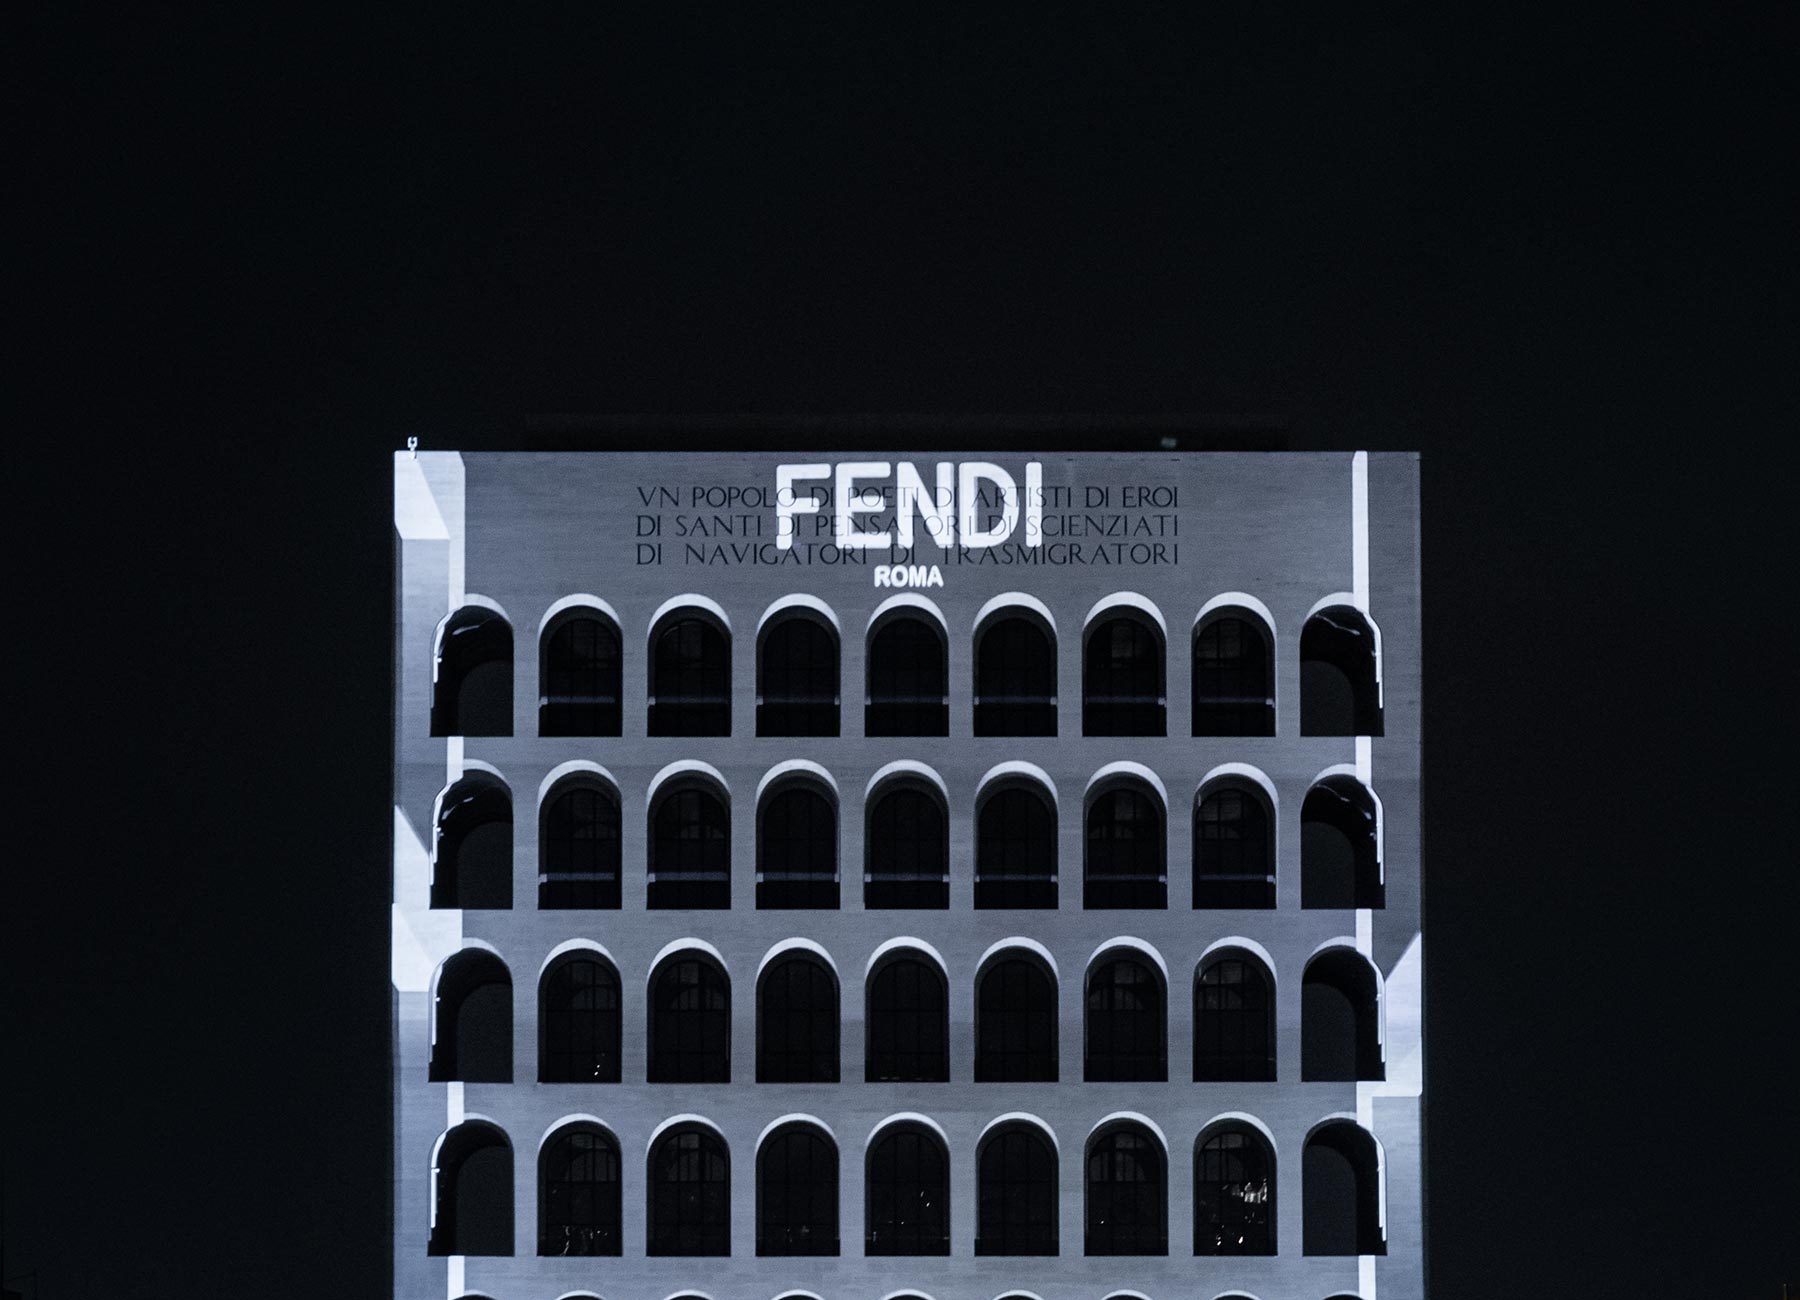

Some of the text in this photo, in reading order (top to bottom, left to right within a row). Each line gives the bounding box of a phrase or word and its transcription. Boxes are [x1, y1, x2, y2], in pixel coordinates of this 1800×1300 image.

[637, 486, 1178, 508] VN POPOLO DI POETI DI ARTISTI DI EROI
[776, 462, 1042, 550] FENDI
[636, 515, 1178, 537] DI SANTI DI PENSATORI DI SCIENZIATI
[636, 543, 1178, 565] DI NAVIGATORI DI TRASMIGRATORI
[874, 565, 944, 588] ROMA
